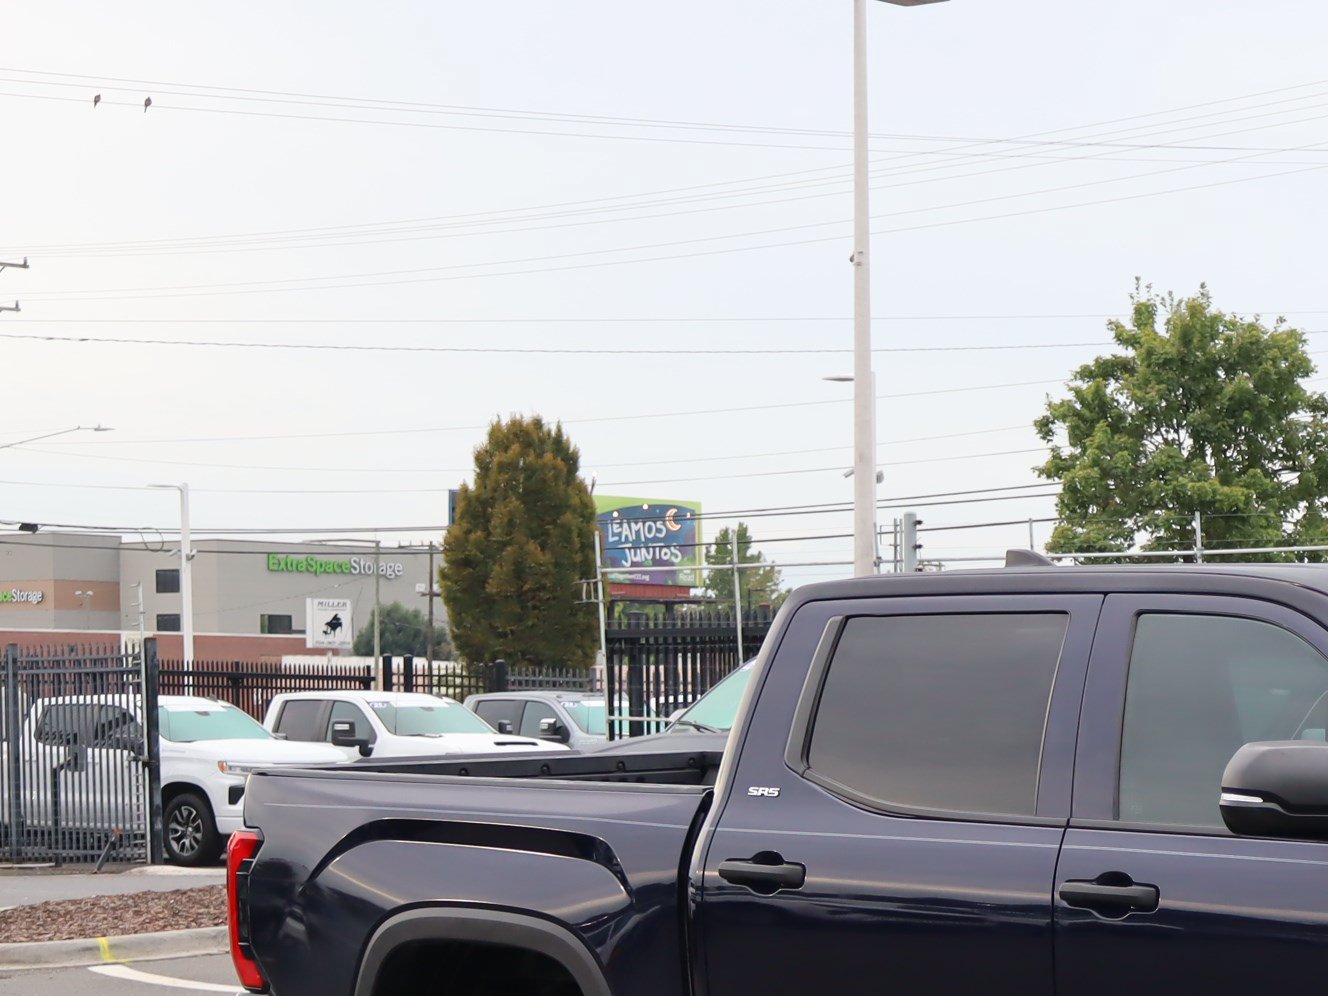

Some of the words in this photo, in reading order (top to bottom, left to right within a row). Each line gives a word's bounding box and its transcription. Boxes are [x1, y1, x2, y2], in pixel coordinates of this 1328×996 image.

[608, 519, 667, 542] LEAMOS
[618, 543, 682, 567] JUNTOS
[747, 786, 781, 797] SR5
